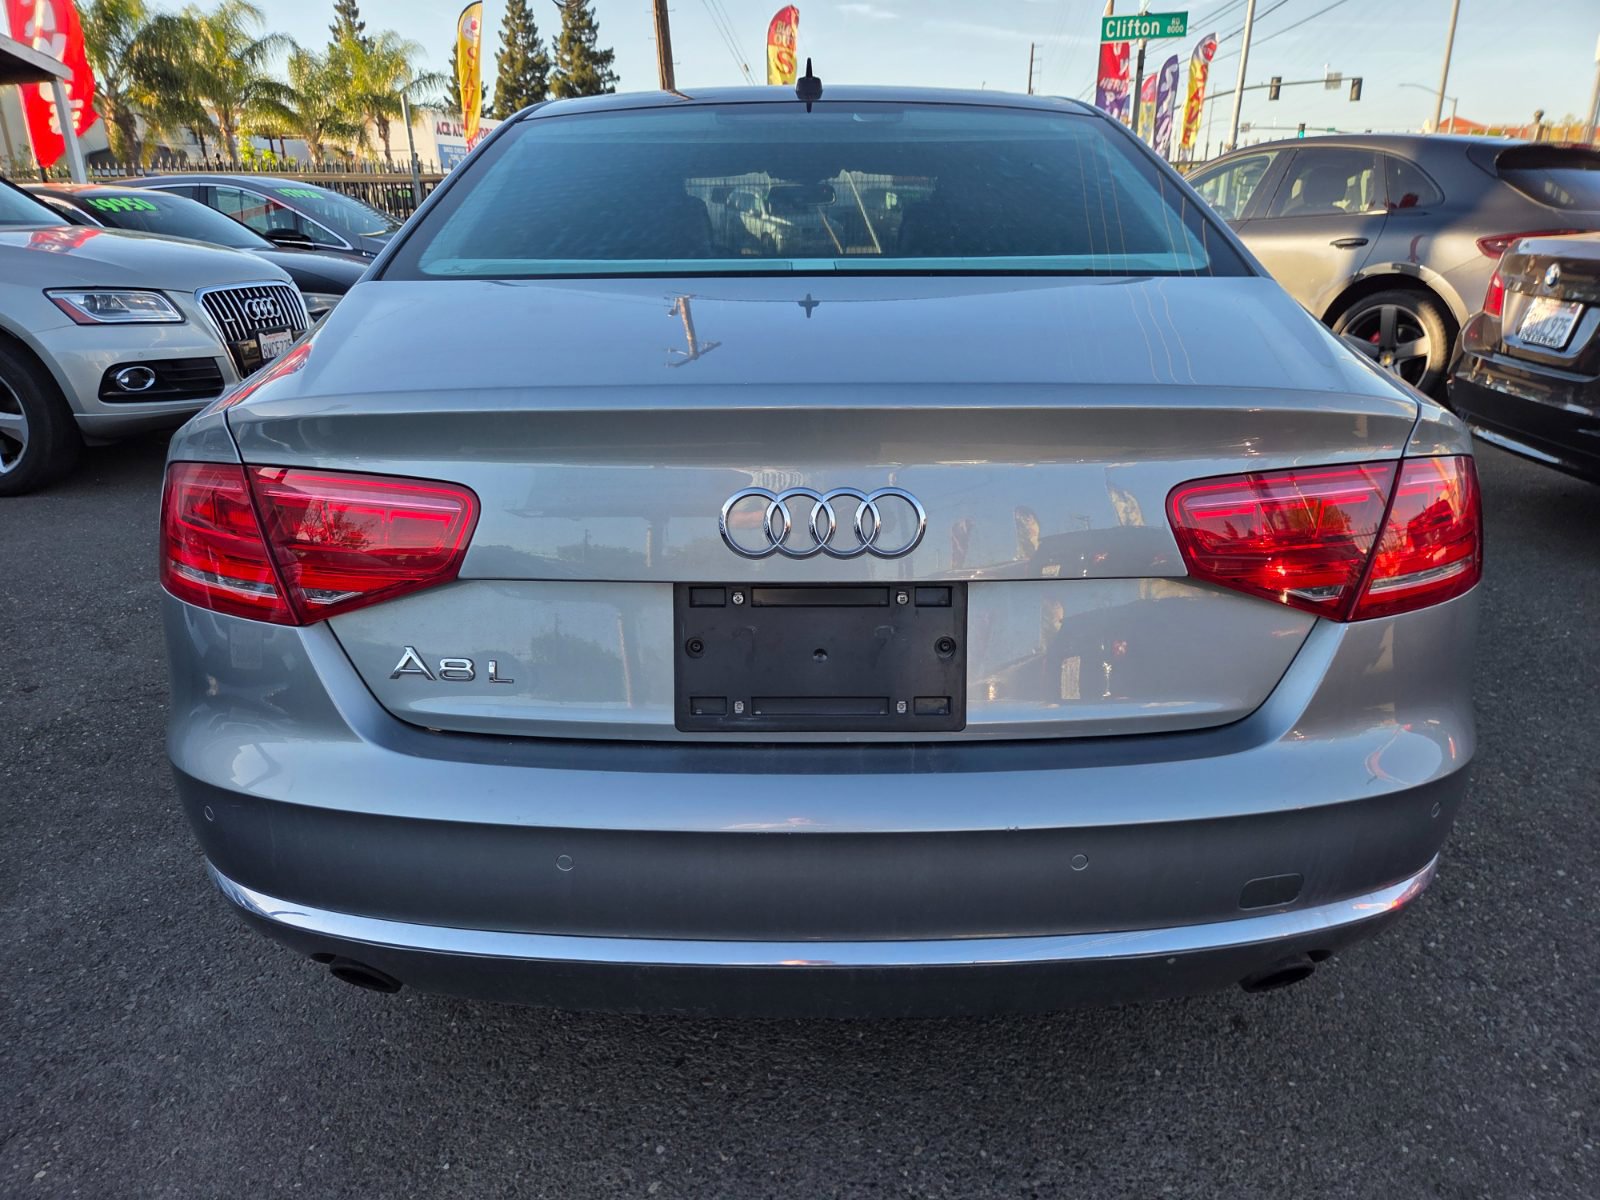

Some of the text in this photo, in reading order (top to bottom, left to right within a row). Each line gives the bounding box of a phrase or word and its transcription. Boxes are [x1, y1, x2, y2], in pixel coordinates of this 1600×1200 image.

[1105, 20, 1160, 38] Clifton
[389, 645, 514, 683] A8 L
